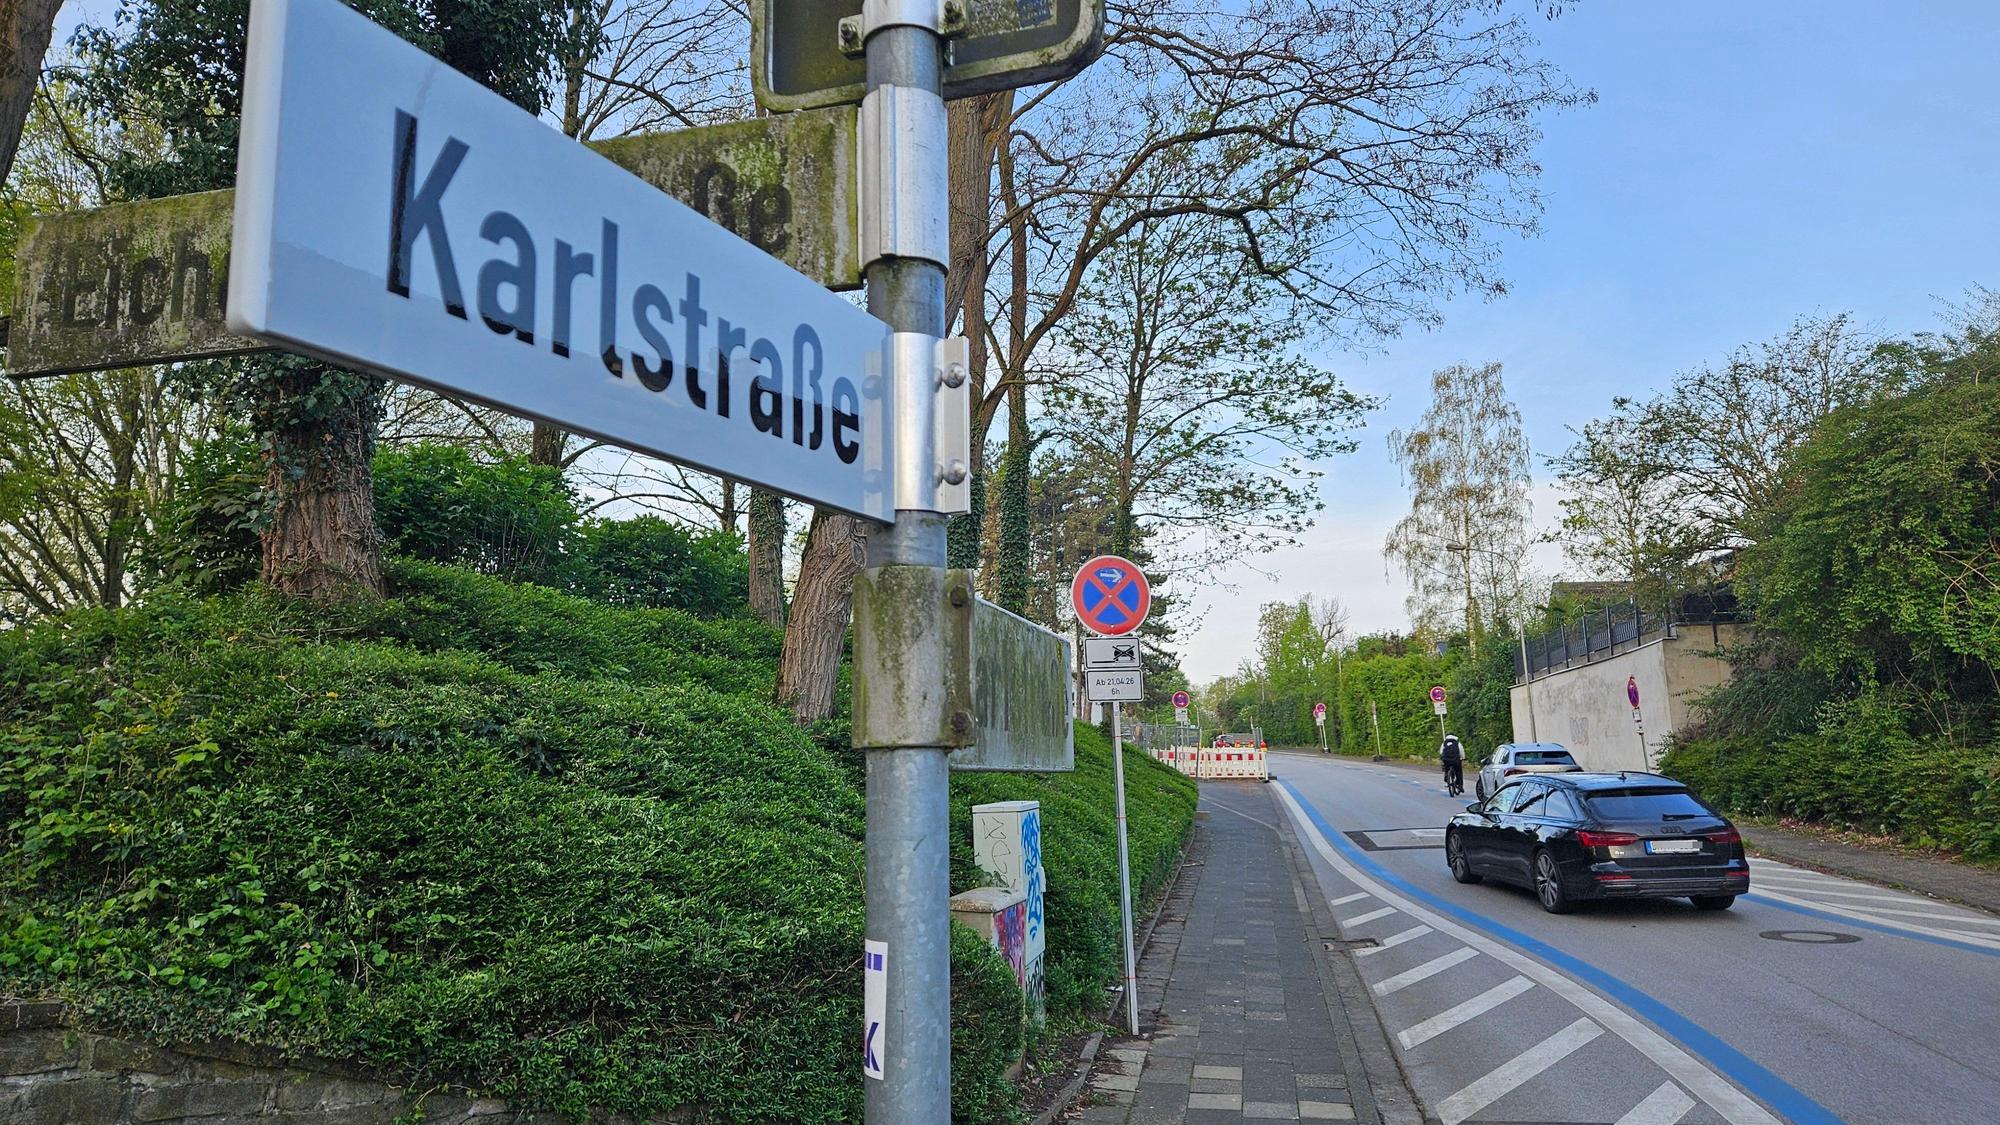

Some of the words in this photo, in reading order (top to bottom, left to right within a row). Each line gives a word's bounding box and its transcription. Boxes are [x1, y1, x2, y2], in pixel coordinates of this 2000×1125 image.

[62, 230, 229, 325] Eich
[387, 106, 860, 465] Karlstraße
[1107, 678, 1134, 686] 21.04.26
